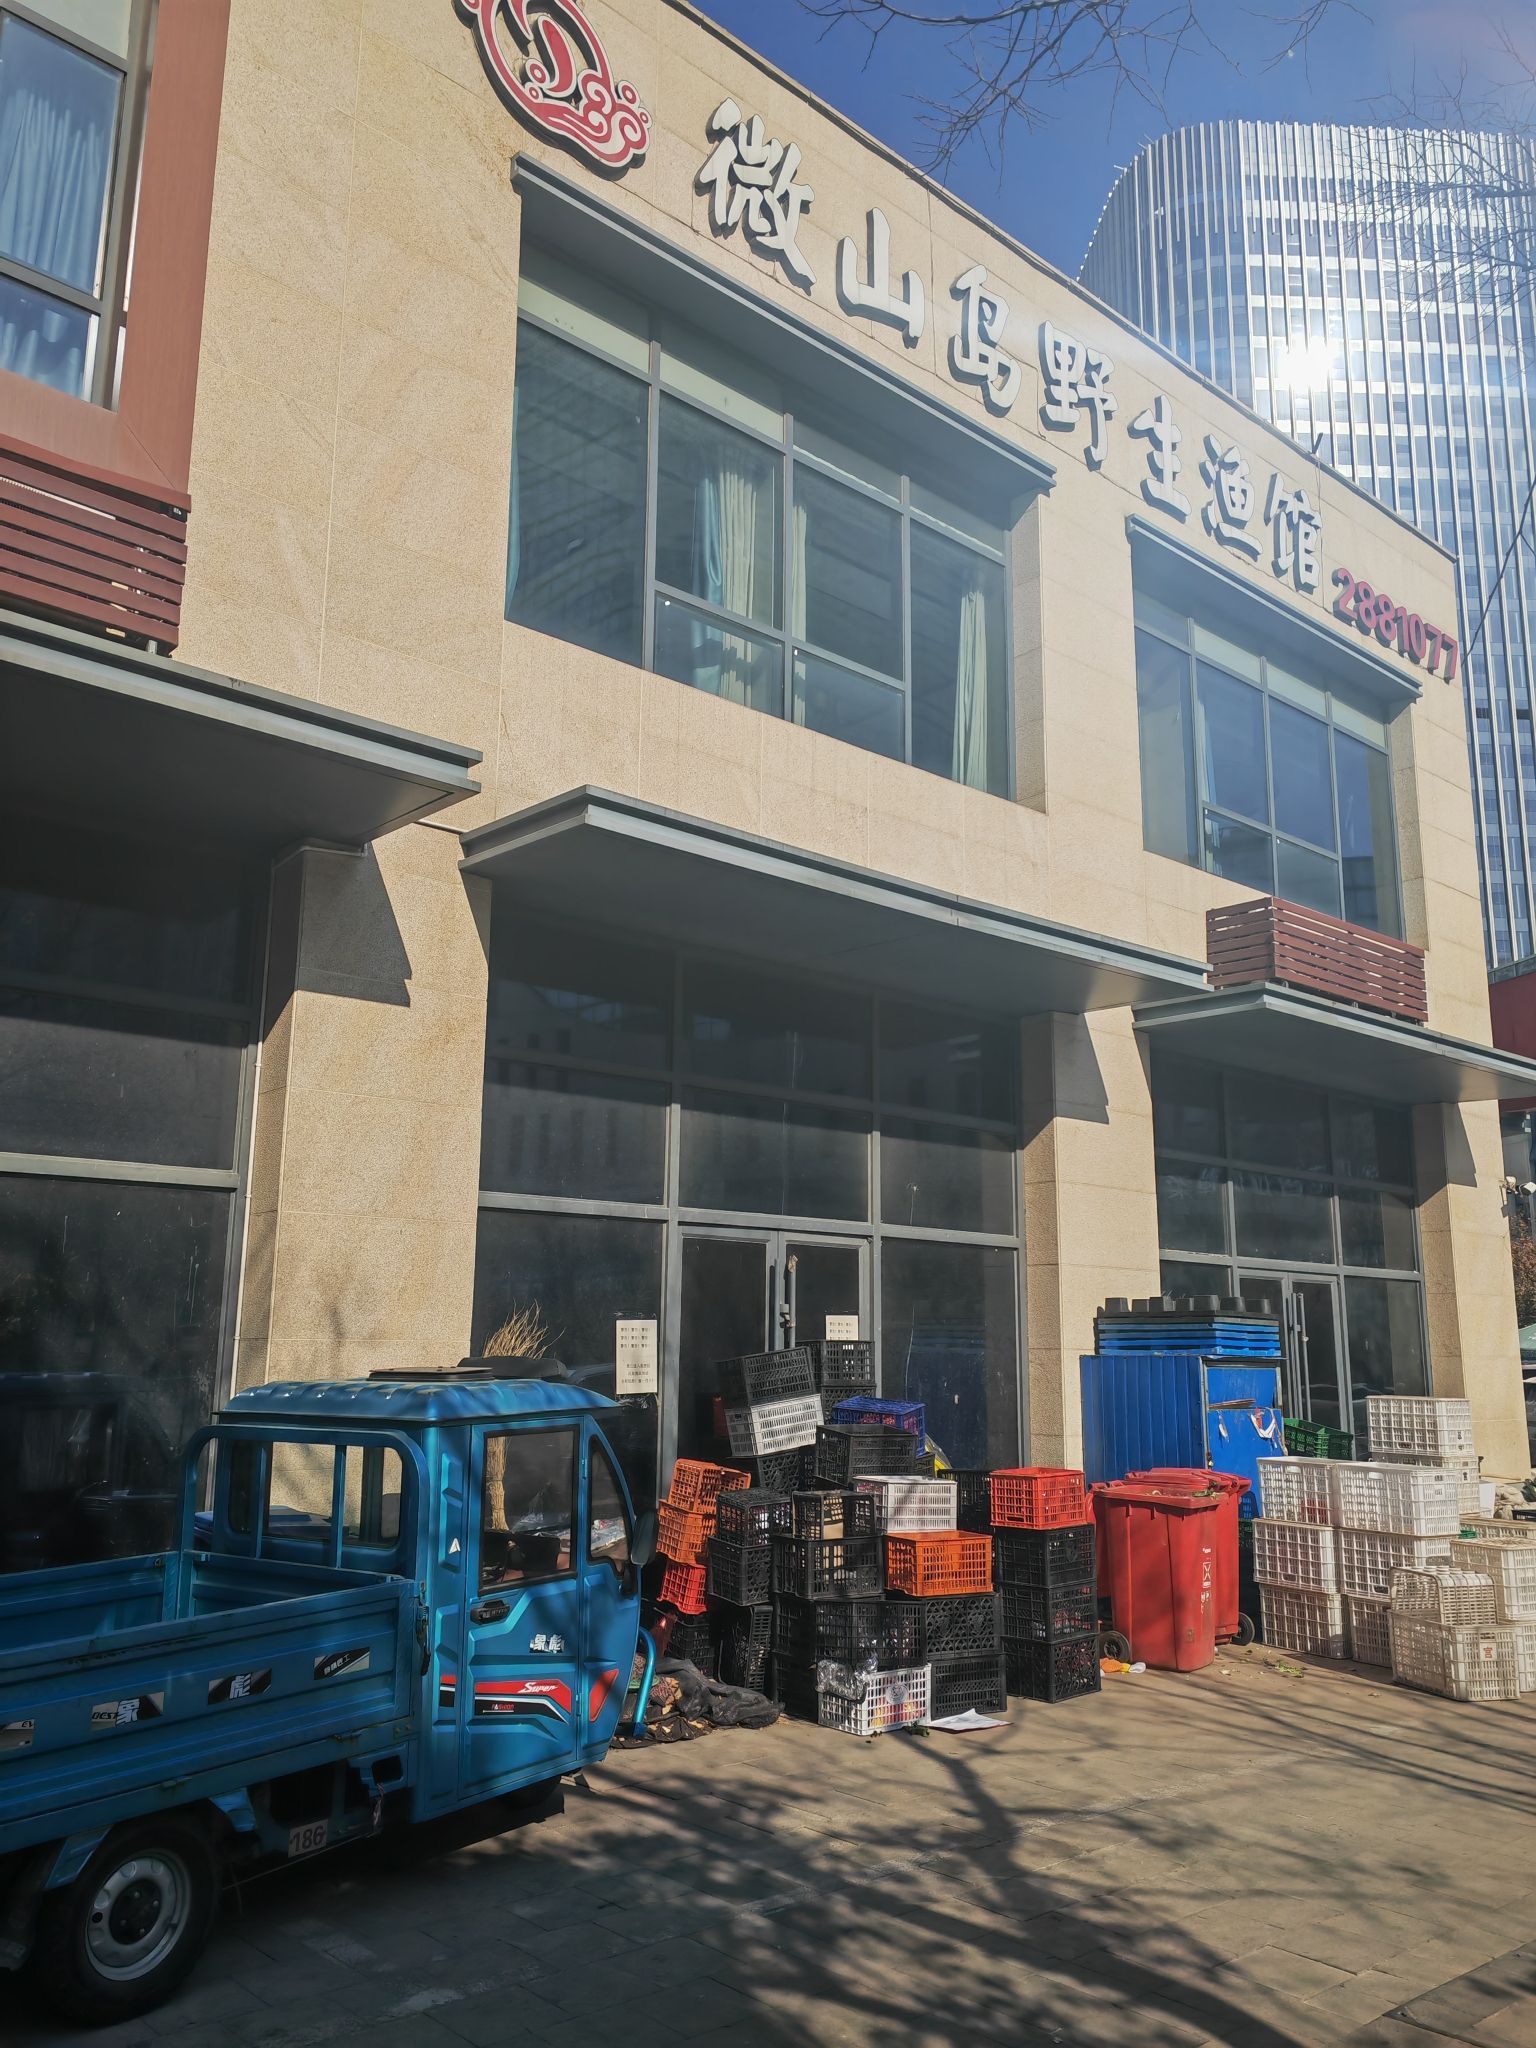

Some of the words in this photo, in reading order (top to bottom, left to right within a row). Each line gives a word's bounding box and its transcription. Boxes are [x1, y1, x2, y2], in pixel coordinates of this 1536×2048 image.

[698, 98, 1324, 592] 微山岛野生渔馆
[1335, 568, 1458, 682] 2881077
